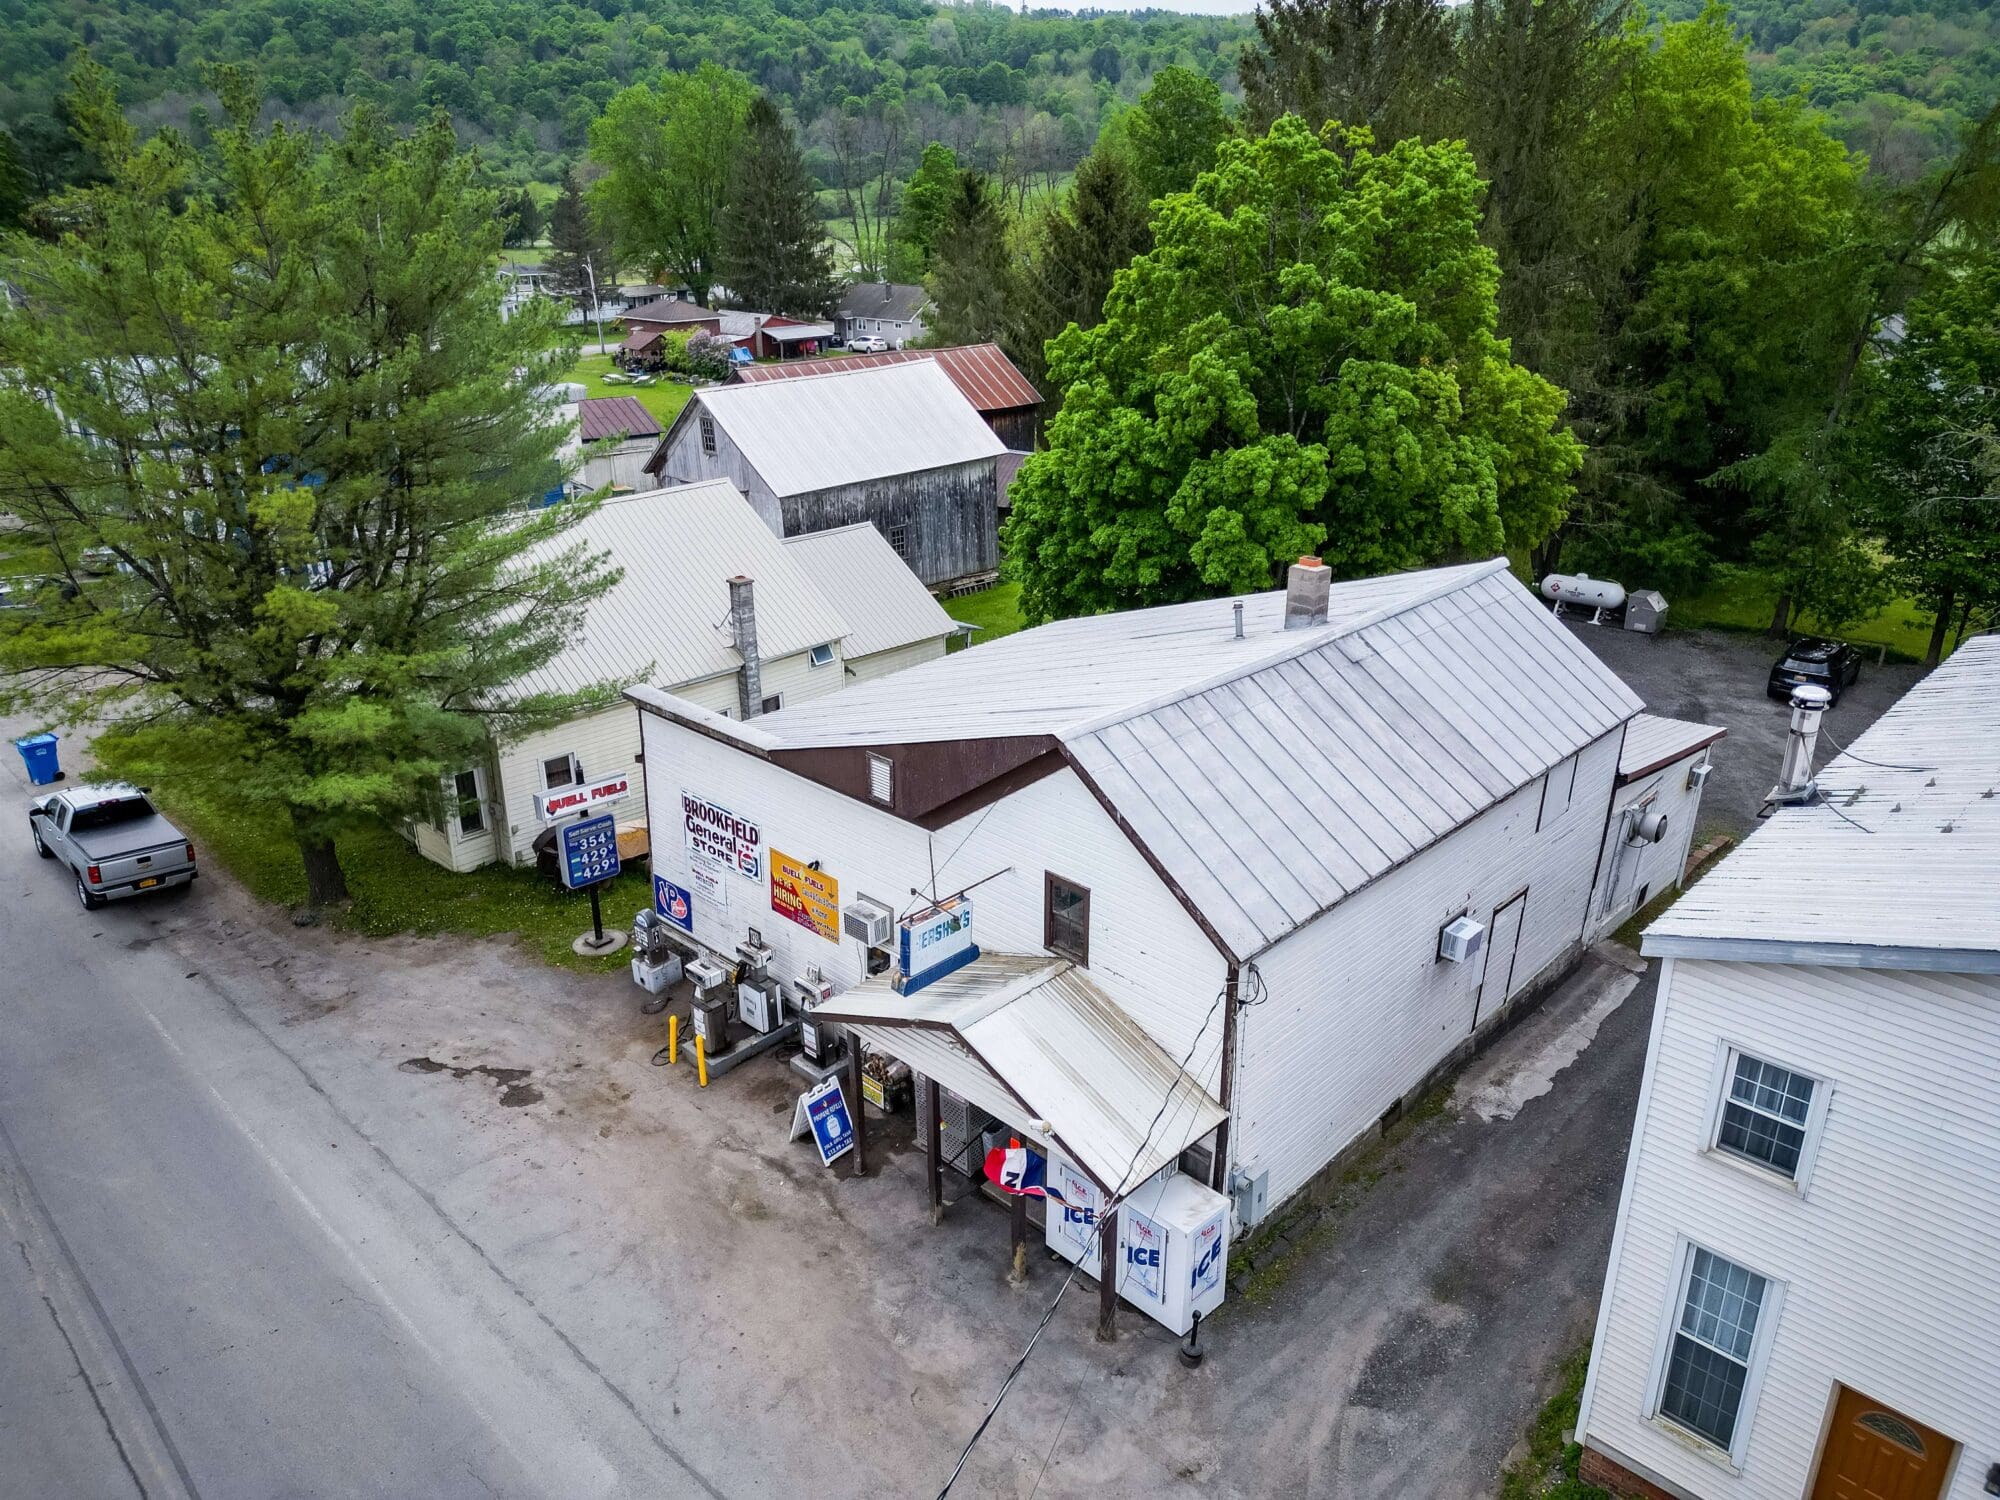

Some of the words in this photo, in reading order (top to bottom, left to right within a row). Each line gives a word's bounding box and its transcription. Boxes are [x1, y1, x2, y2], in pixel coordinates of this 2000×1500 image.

[591, 780, 628, 800] FUELS
[683, 796, 759, 845] BROOKFIELD
[686, 814, 737, 854] General
[692, 837, 733, 864] STORE
[782, 865, 801, 881] BUELL
[805, 876, 824, 891] FUELS
[773, 884, 803, 910] HIRING
[1064, 1206, 1094, 1225] ICE
[1127, 1246, 1160, 1268] ICE
[1191, 1234, 1222, 1289] ICE
